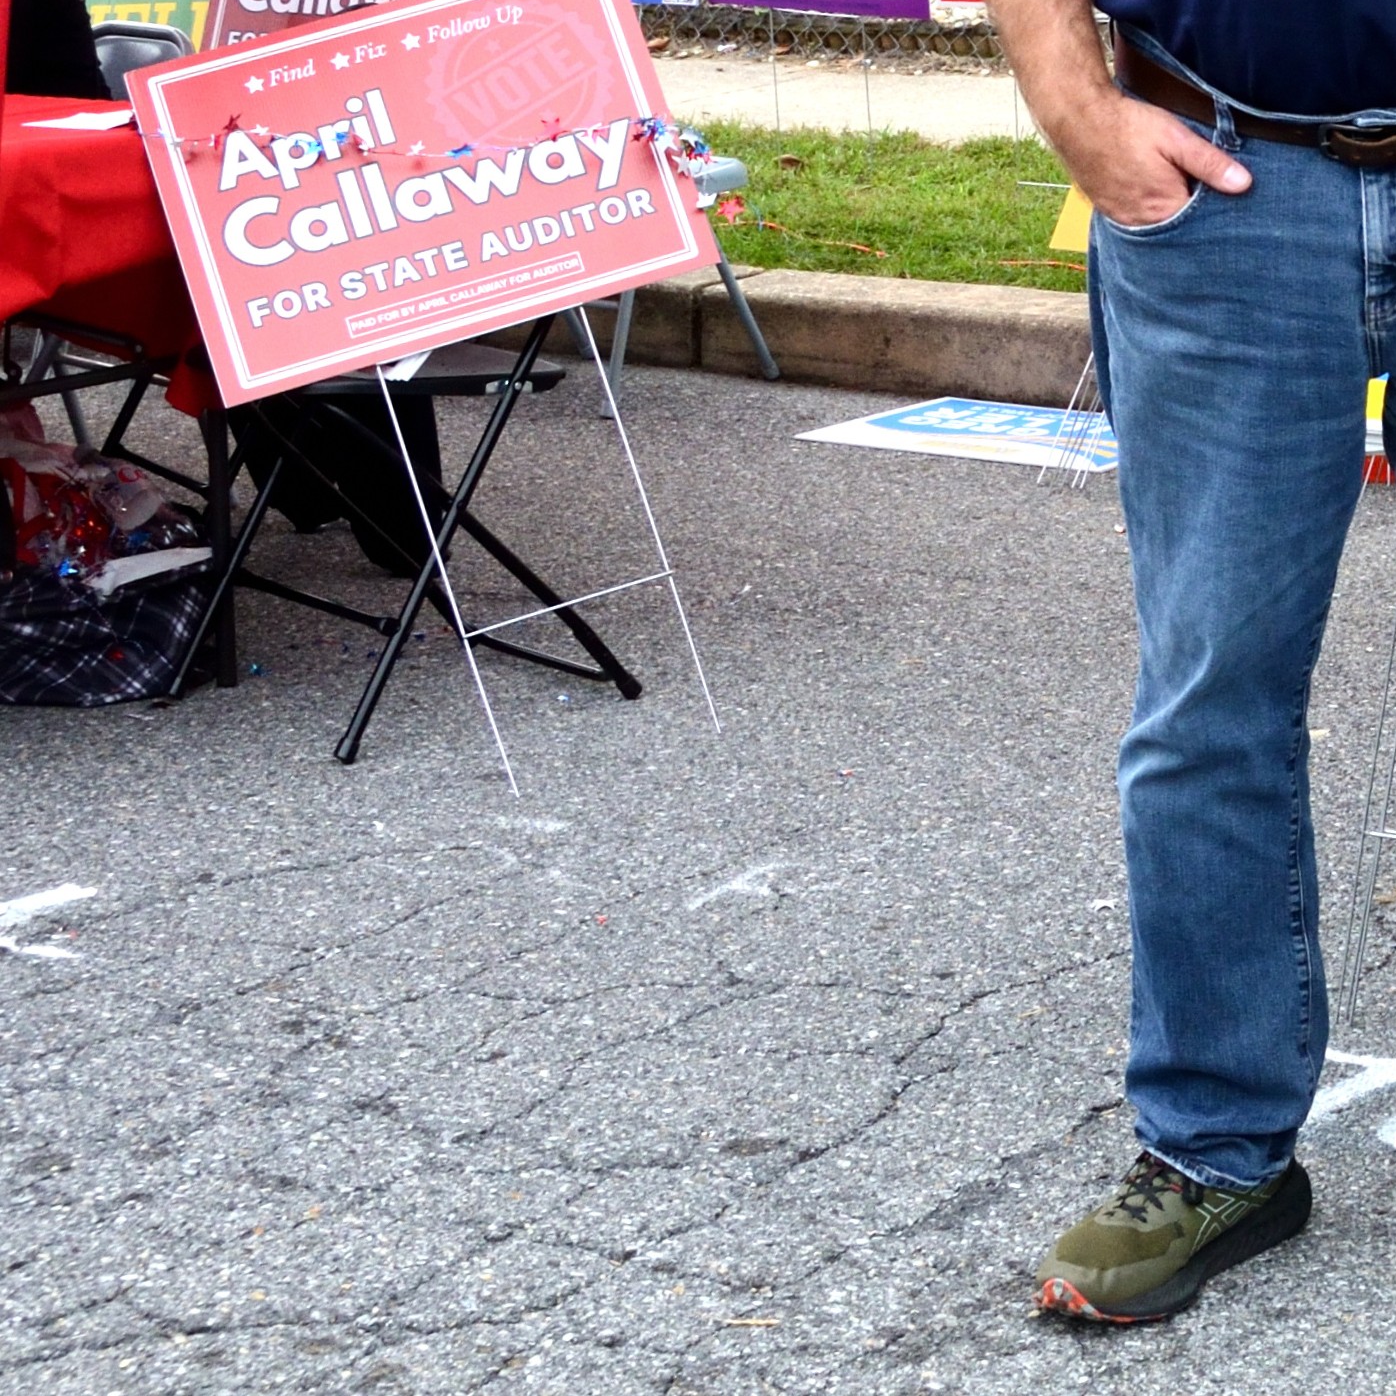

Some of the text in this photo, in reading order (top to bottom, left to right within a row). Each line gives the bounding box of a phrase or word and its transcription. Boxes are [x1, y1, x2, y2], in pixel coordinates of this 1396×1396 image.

[354, 42, 387, 64] Fix
[427, 5, 523, 43] Follow Up
[269, 59, 316, 87] Find
[452, 30, 586, 120] VOTE
[218, 88, 397, 193] April
[222, 117, 631, 266] Callaway
[246, 187, 656, 328] FOR STATE AUDITOR
[351, 258, 580, 332] PAID FOR BY APRIL CALLAWAY FOR AUDITOR
[898, 416, 1049, 436] GREG
